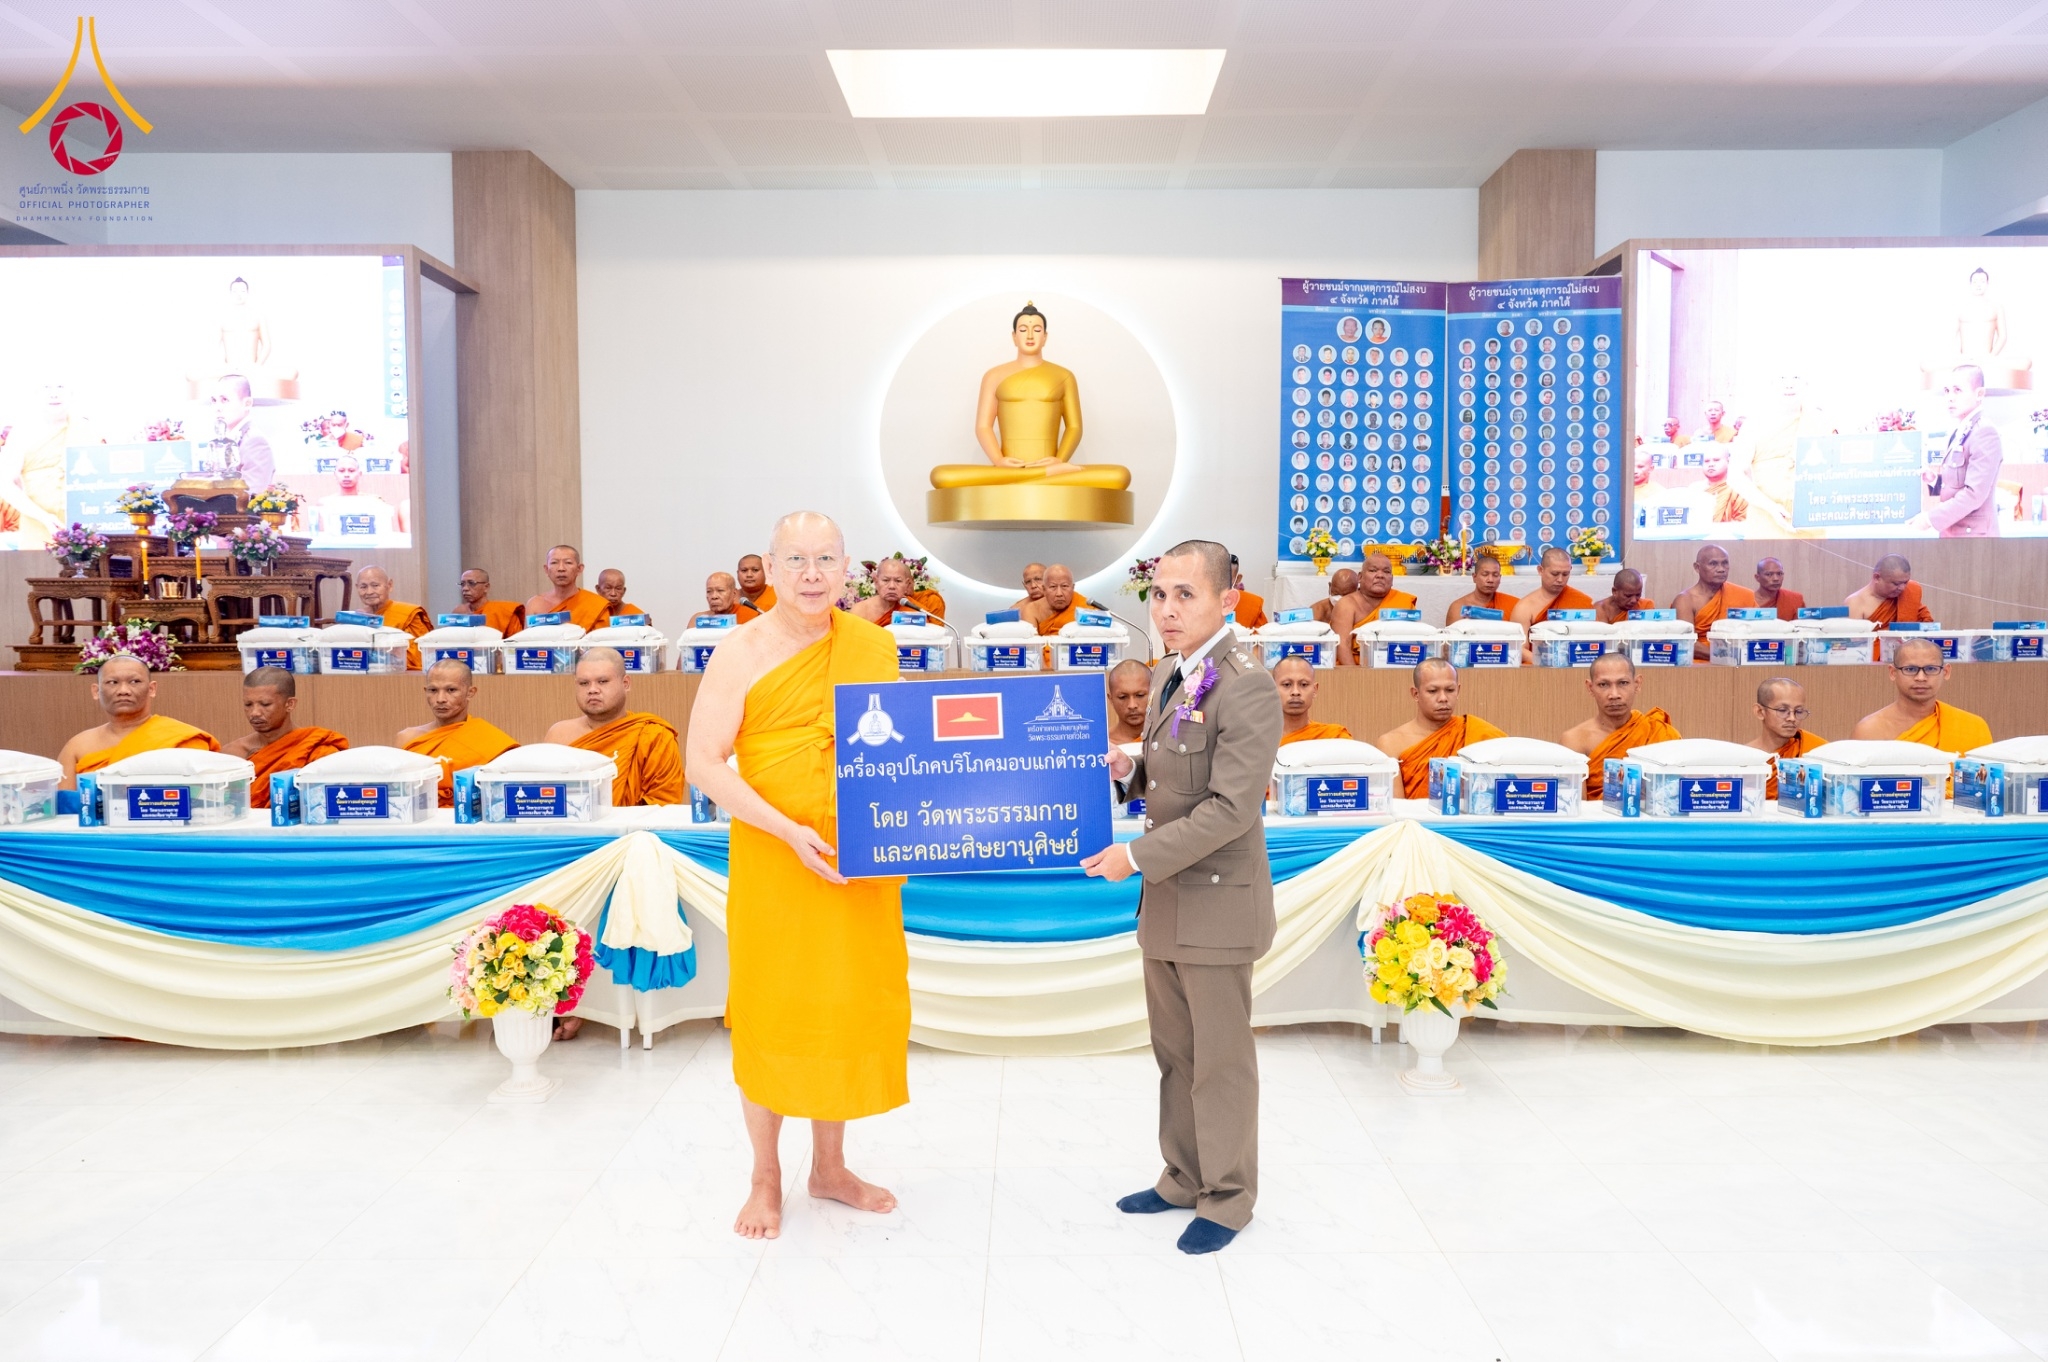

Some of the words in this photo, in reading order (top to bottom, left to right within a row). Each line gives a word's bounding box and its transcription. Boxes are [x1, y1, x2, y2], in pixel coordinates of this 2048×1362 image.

[1302, 280, 1427, 295] ผู้วายชนม์จากเหตุการณ์ไม่สงบ
[1468, 282, 1600, 300] ผู้วายชนม์จากเหตุการณ์ไม่สงบ
[1329, 296, 1338, 304] ๔
[1340, 294, 1369, 305] จังหวัด
[1371, 295, 1399, 306] ภาคใต้
[1497, 301, 1505, 309] ๔
[1508, 298, 1538, 309] จังหวัด
[1541, 296, 1571, 308] ภาคใต้
[837, 748, 1107, 783] เครื่องอุปโภคบริโภคมอบแก่ตำรวจ
[869, 802, 908, 829] โดย
[917, 800, 1079, 826] วัดพระธรรมกาย
[873, 828, 1079, 864] และคณะศิษยานุศิษย์
